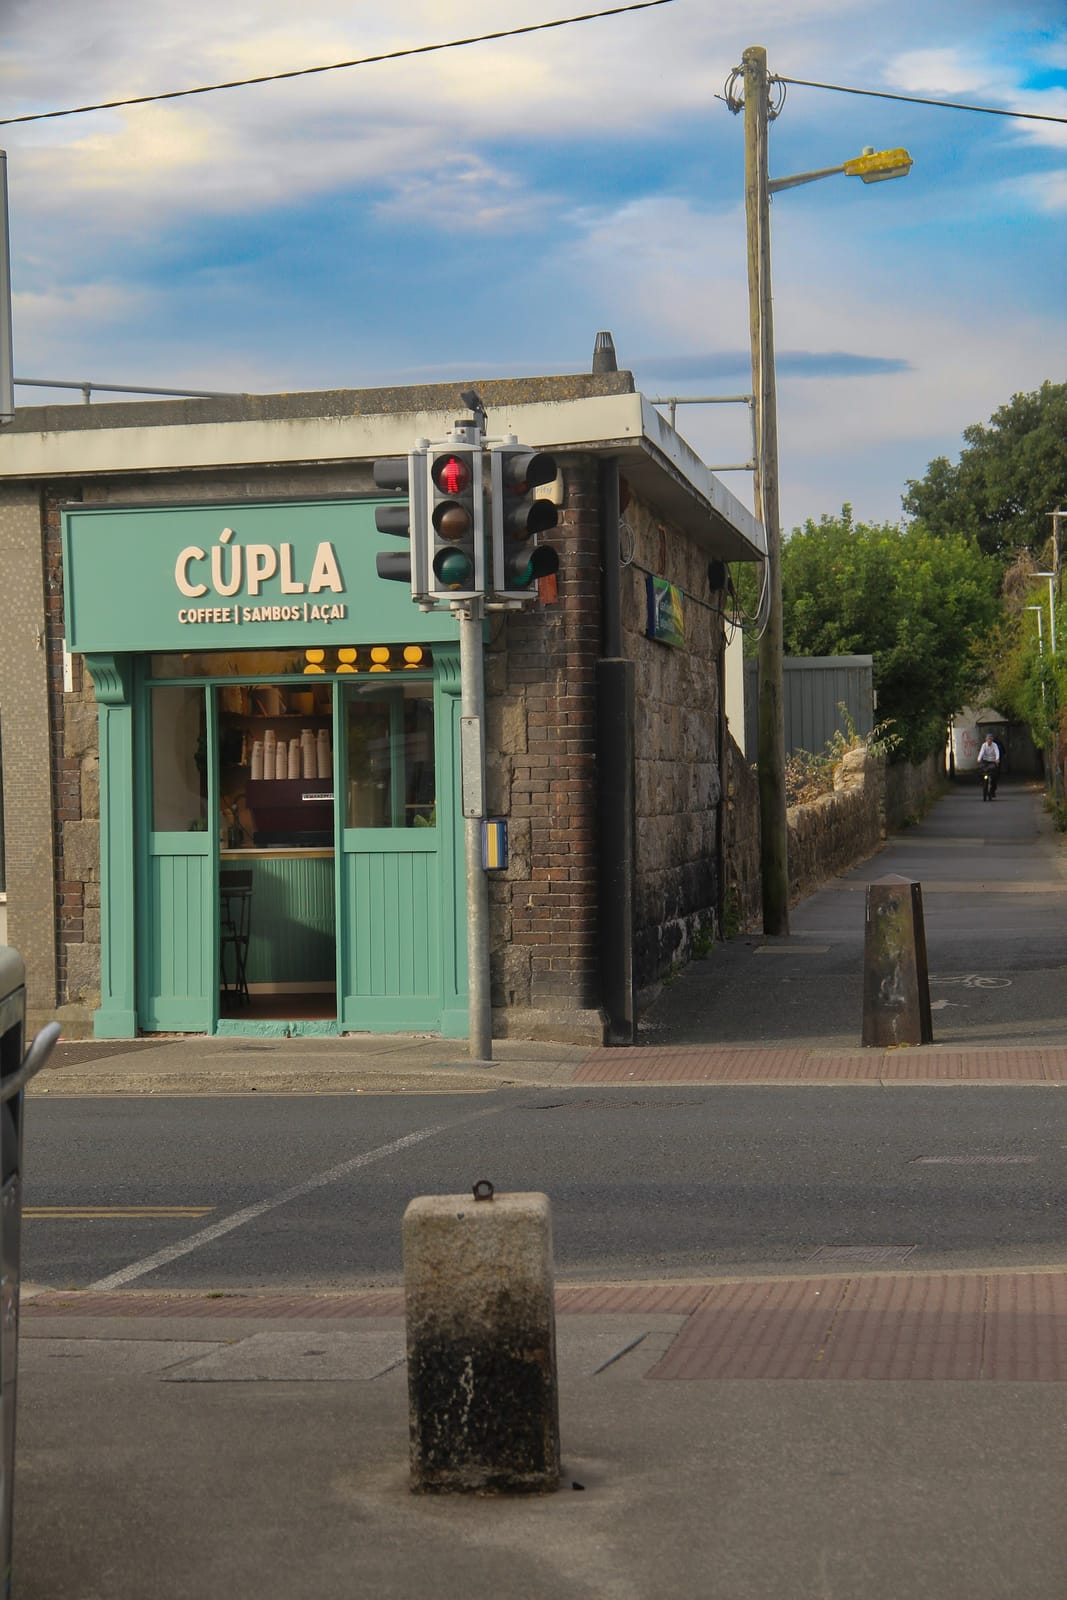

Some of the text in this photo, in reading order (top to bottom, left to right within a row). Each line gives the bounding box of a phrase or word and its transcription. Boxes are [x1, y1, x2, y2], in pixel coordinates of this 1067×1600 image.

[174, 527, 344, 598] CÚPLA
[178, 604, 345, 624] COFFEE SAMBOS AÇAI
